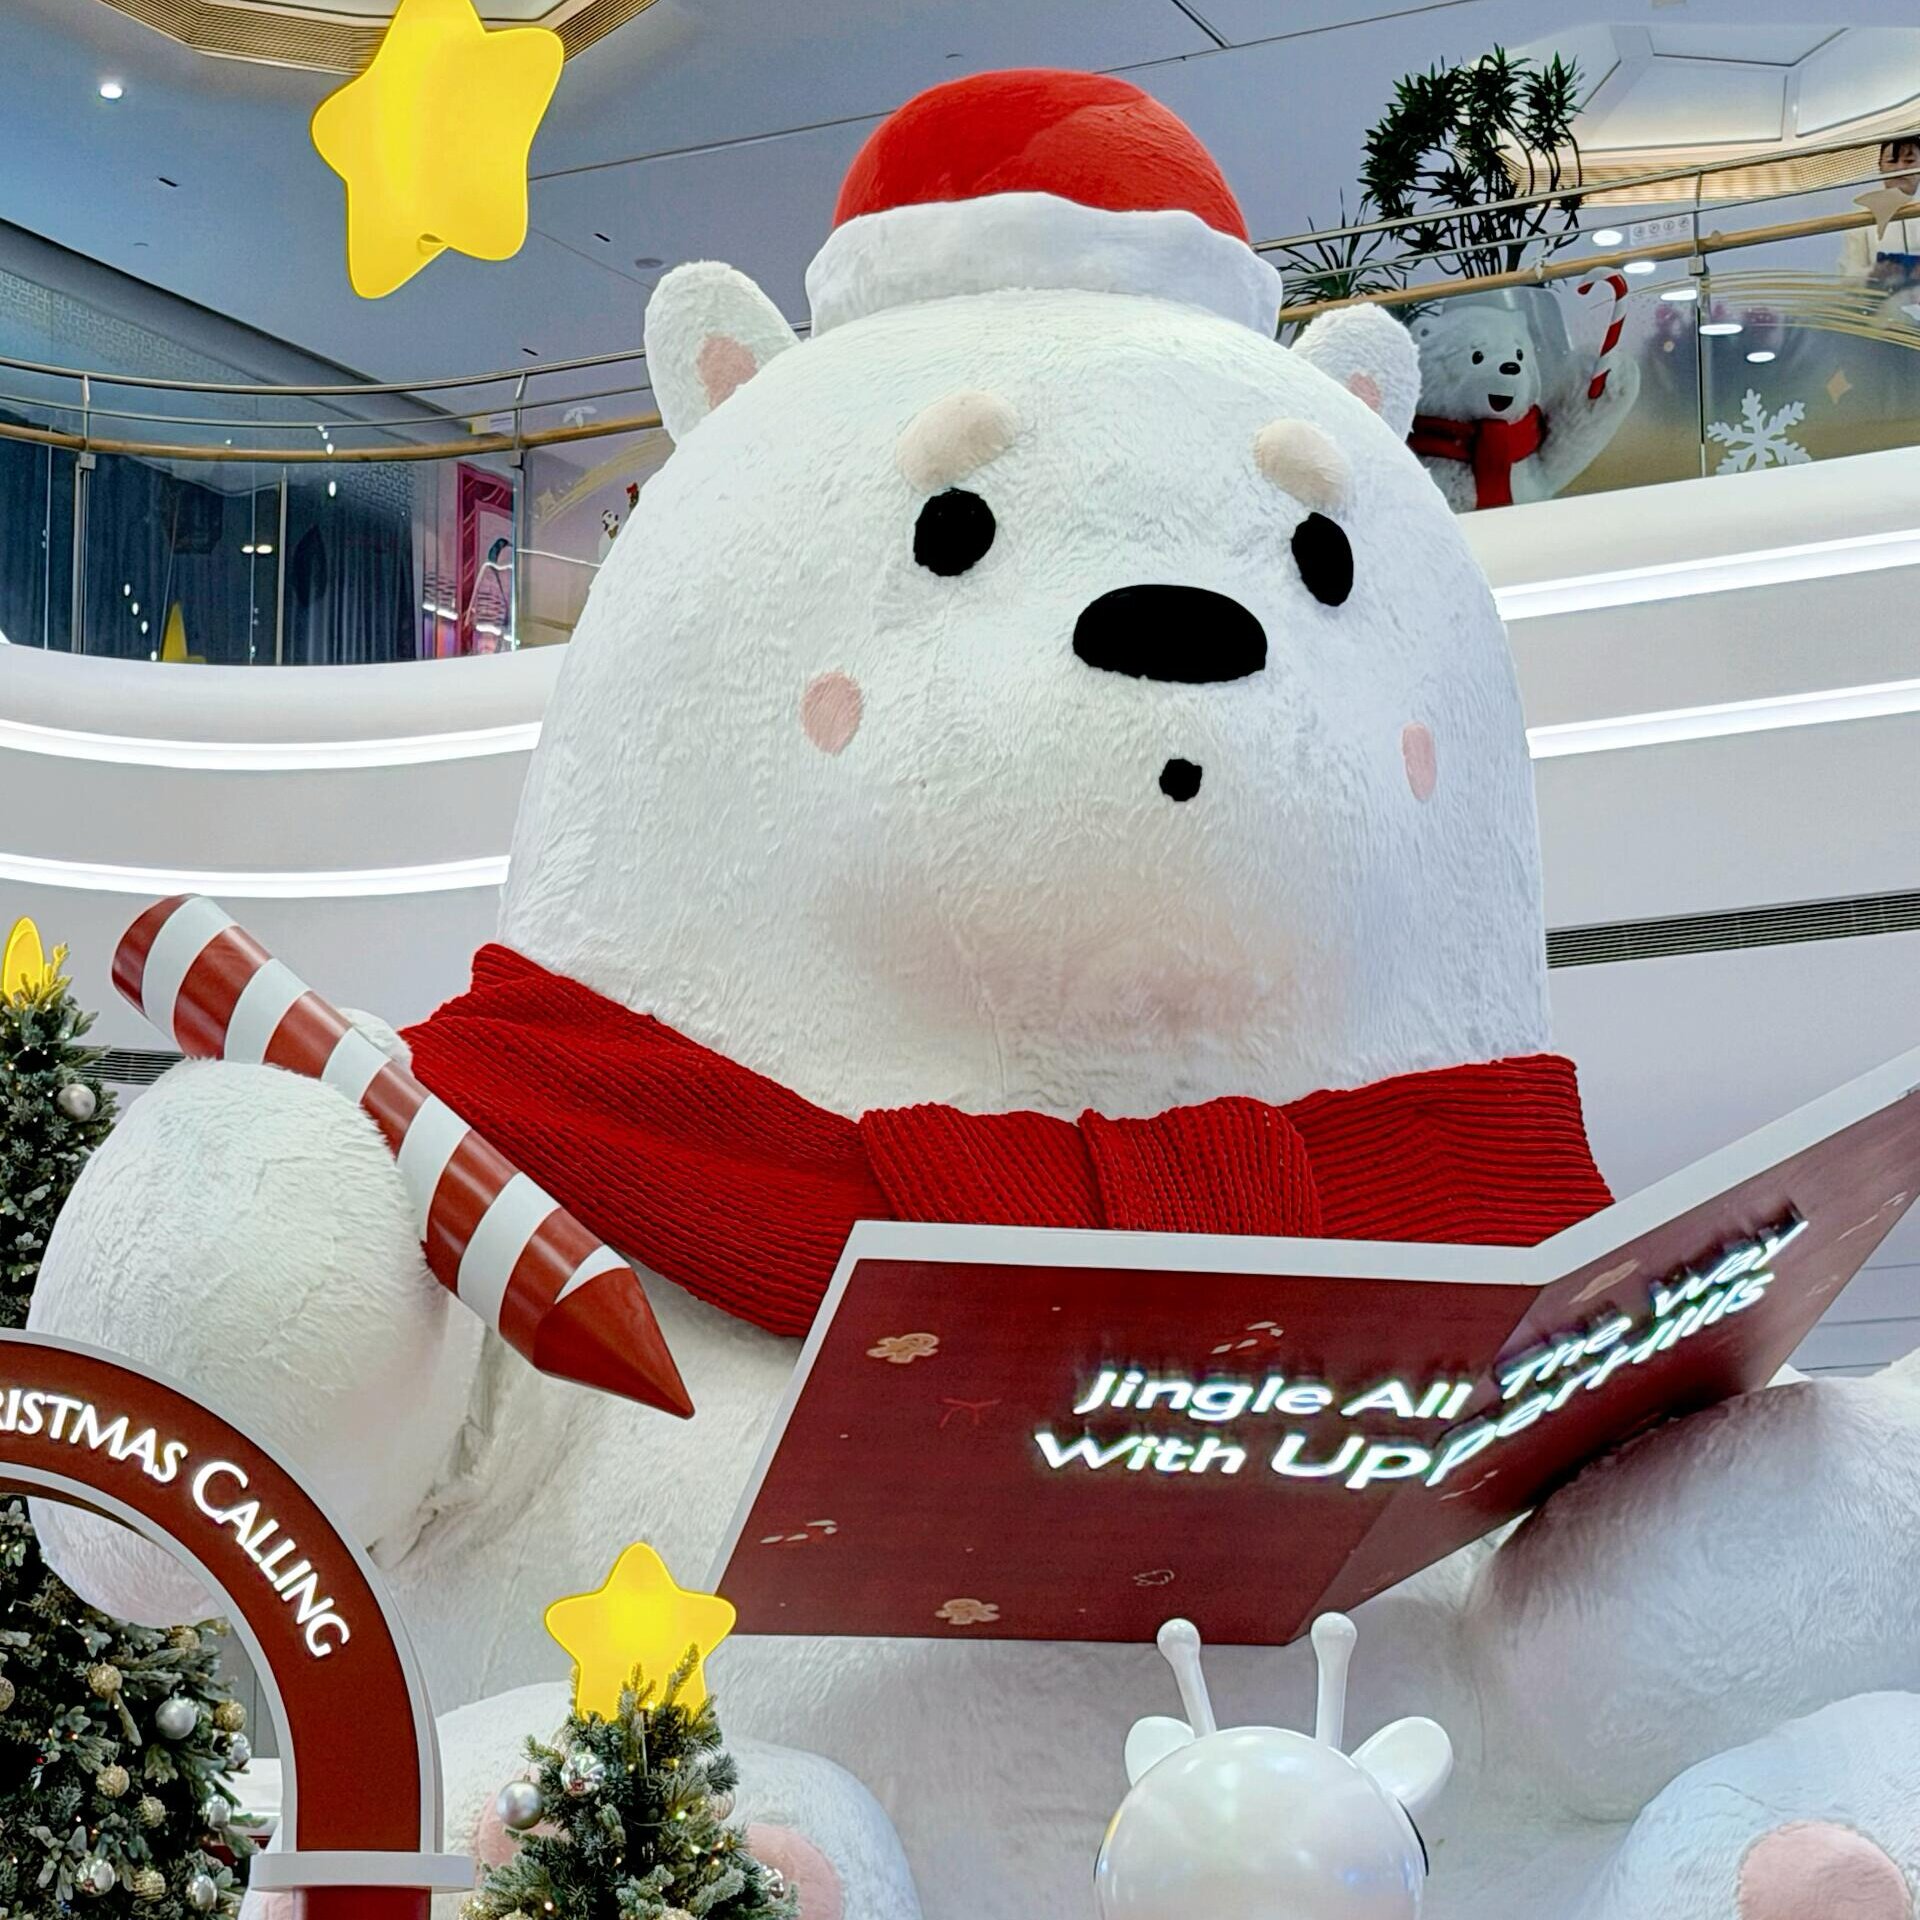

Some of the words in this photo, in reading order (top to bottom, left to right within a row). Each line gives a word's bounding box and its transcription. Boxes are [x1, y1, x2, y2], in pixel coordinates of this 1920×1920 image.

[1073, 1371, 1333, 1421] Jingle
[1341, 1380, 1473, 1420] All
[1501, 1316, 1632, 1400] The
[1653, 1220, 1806, 1318] Way
[1034, 1432, 1247, 1475] With
[192, 1461, 350, 1658] CALLING
